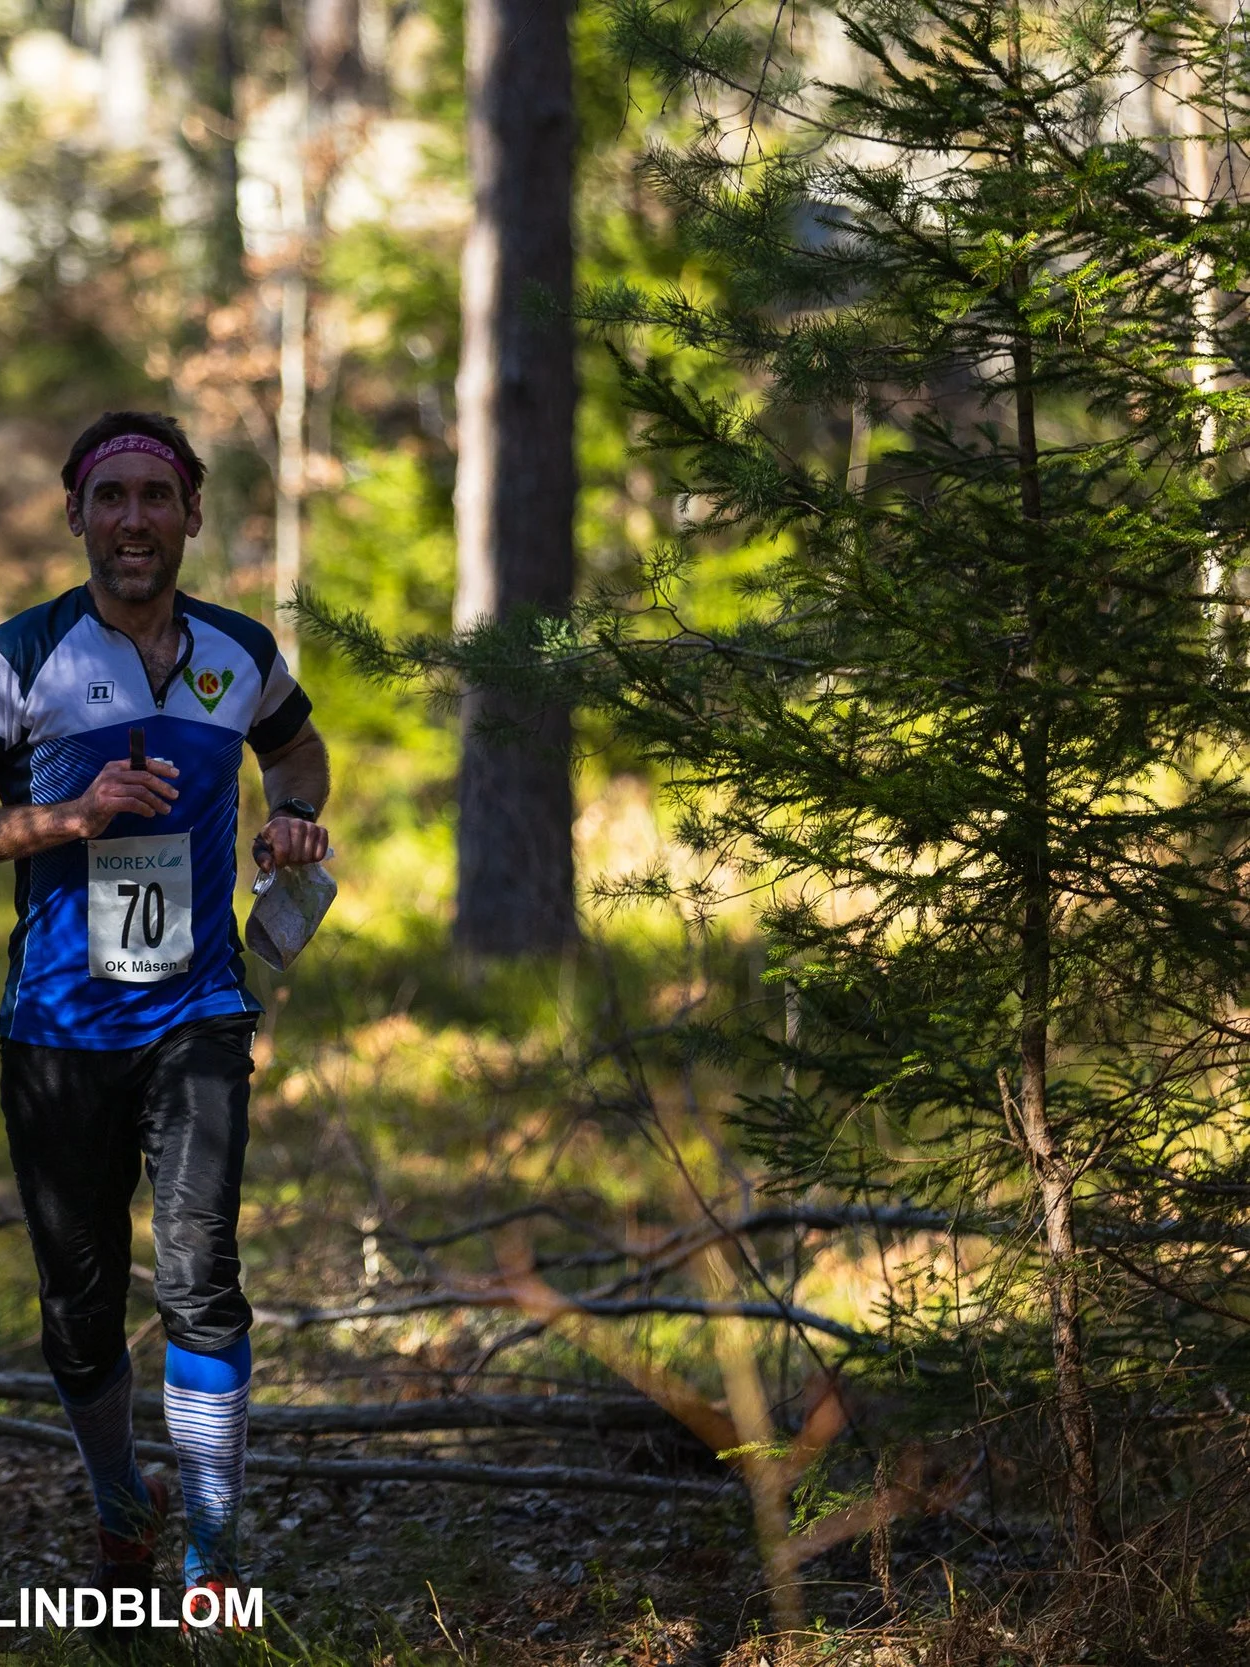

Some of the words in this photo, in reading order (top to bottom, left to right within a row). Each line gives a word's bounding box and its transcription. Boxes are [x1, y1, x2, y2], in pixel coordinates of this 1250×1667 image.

[203, 673, 217, 693] K
[96, 856, 156, 870] NOREX
[117, 882, 165, 949] 70
[105, 961, 127, 972] OK
[132, 960, 177, 973] Måsen
